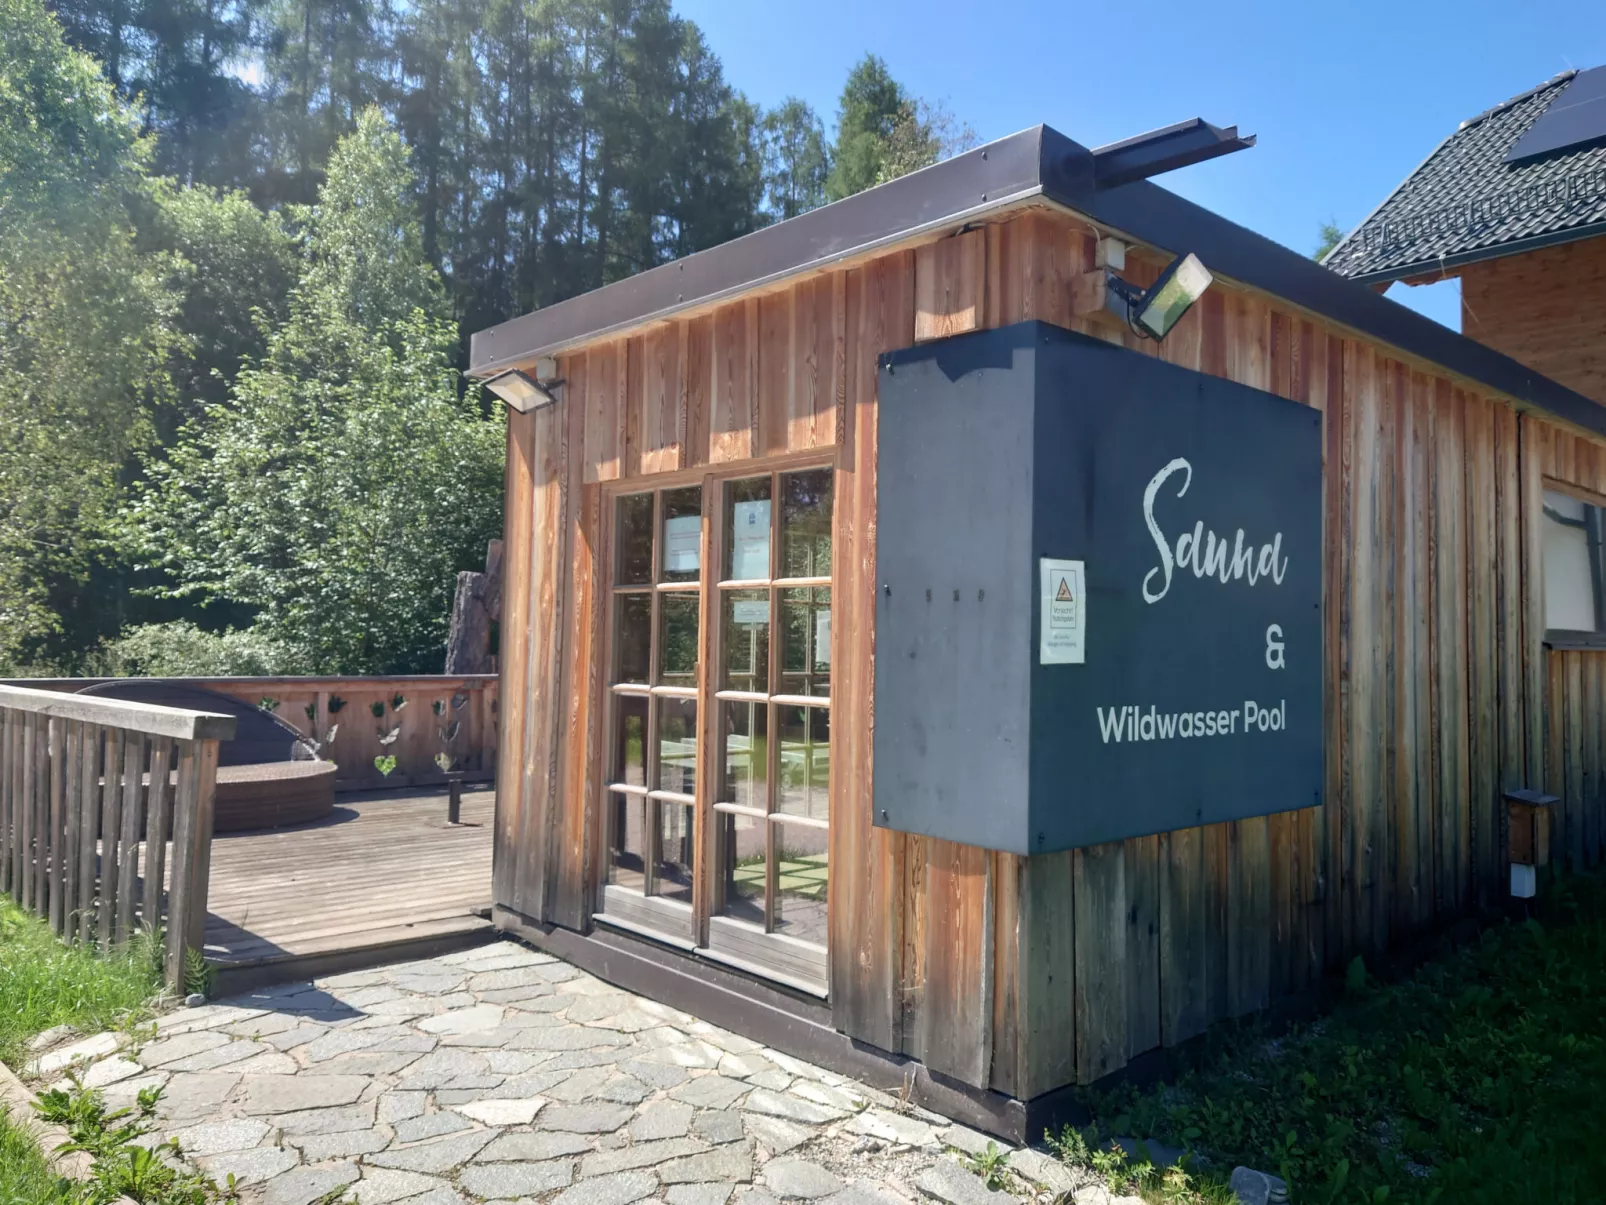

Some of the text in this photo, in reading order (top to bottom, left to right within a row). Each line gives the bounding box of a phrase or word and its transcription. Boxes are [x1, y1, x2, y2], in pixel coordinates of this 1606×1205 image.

[1143, 457, 1288, 604] Sauna
[1265, 623, 1286, 670] &
[1096, 699, 1286, 744] Wildwasser Pool
